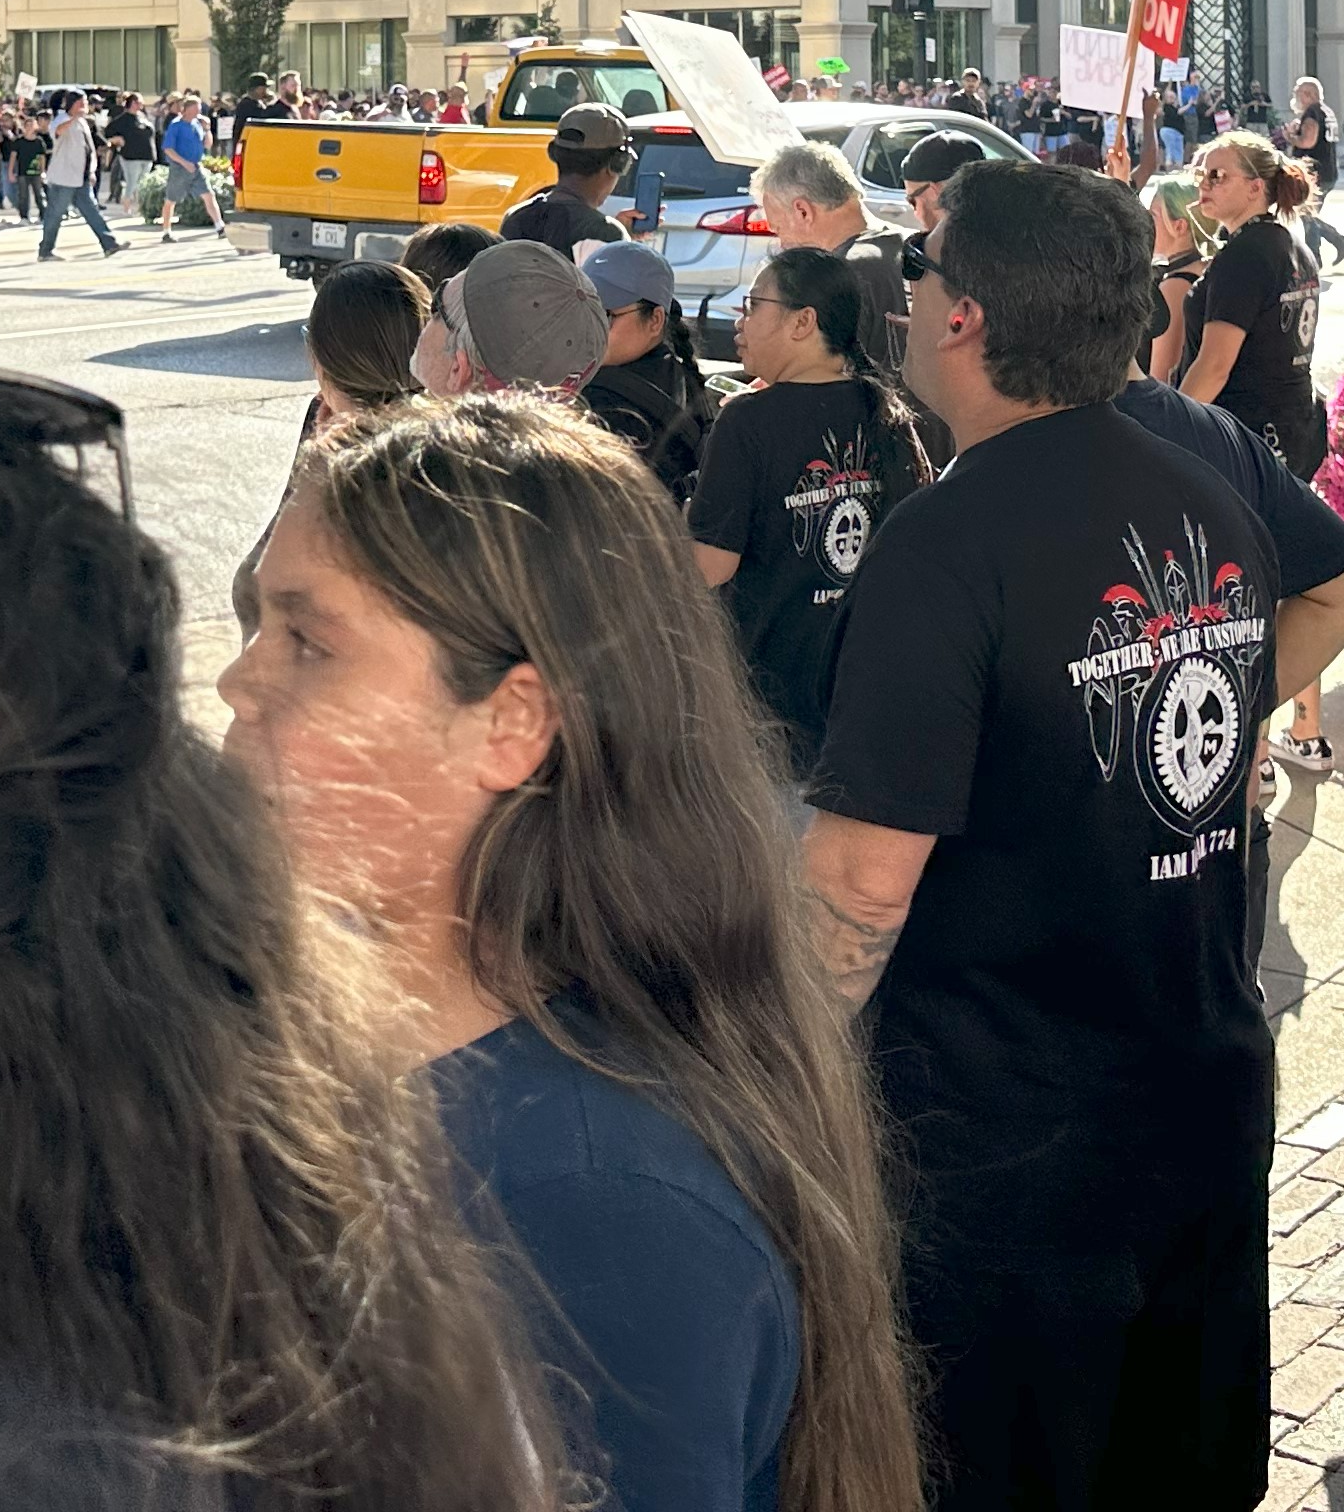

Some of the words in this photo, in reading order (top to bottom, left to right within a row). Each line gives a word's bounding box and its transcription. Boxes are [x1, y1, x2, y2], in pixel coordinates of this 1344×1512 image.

[1068, 641, 1155, 687] TOGETHER
[1159, 634, 1181, 662] WE
[1204, 739, 1217, 755] M
[1150, 851, 1188, 881] IAM
[1209, 827, 1236, 852] 774
